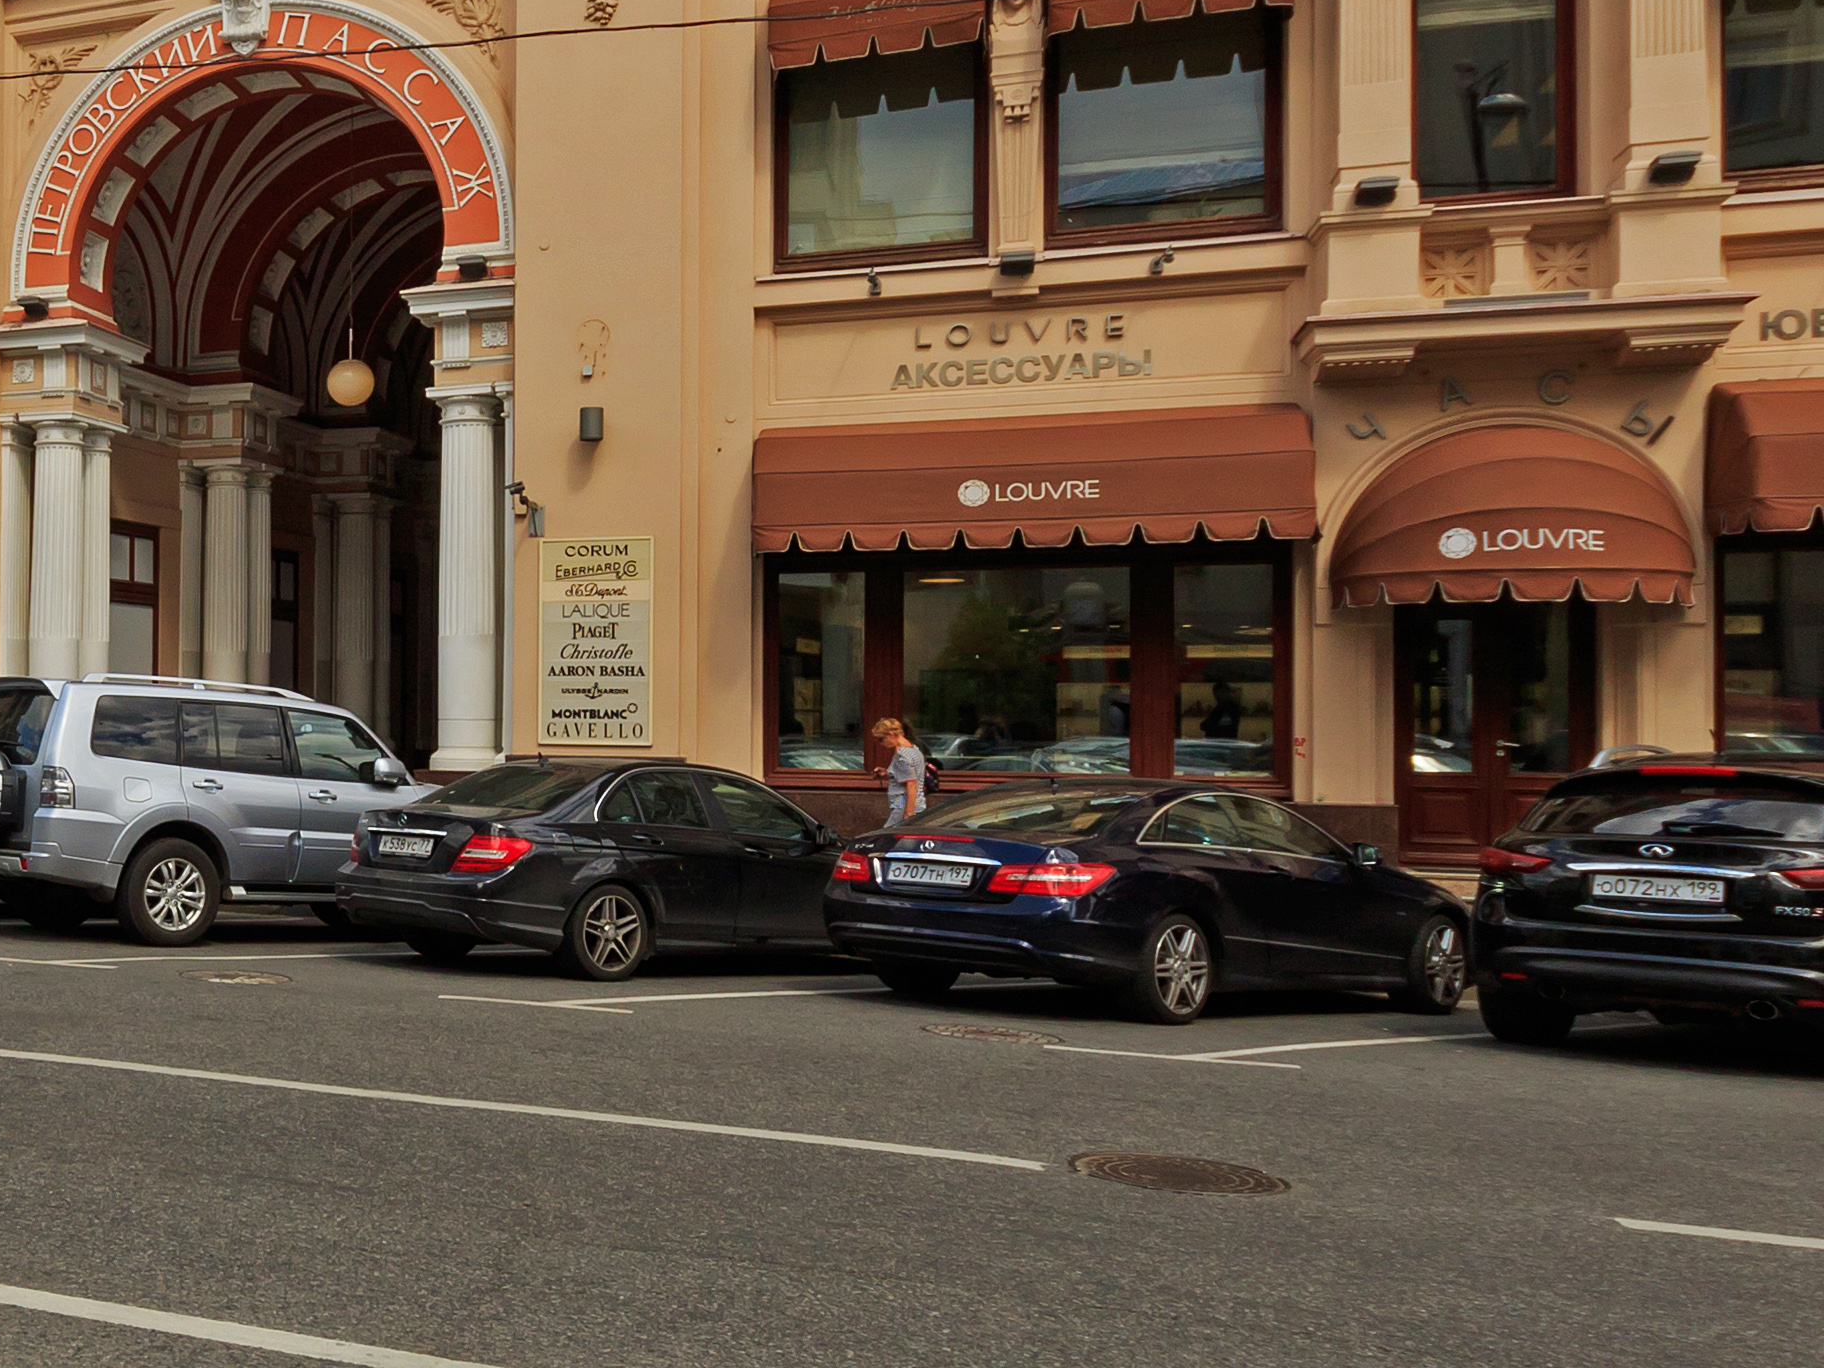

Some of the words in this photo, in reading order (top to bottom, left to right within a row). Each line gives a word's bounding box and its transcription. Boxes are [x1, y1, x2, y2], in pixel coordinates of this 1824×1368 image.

[28, 23, 218, 255] ПЕТРОВСКИЙ
[276, 11, 494, 209] ПАССАЖ
[914, 313, 1124, 348] LOUVRE
[890, 349, 1152, 390] АКСЕССУАРЫ
[1347, 370, 1675, 445] ЧАСЫ
[994, 479, 1101, 502] LOUVRE
[1482, 528, 1605, 553] LOUVRE
[564, 544, 628, 557] CORUM
[562, 603, 630, 619] LALIQUE
[572, 622, 619, 640] PIAGET
[560, 643, 633, 659] Christofle
[548, 665, 595, 677] AARON
[599, 665, 645, 677] BASHA
[551, 708, 628, 720] MONTBLANC
[546, 722, 644, 739] GAVELLO
